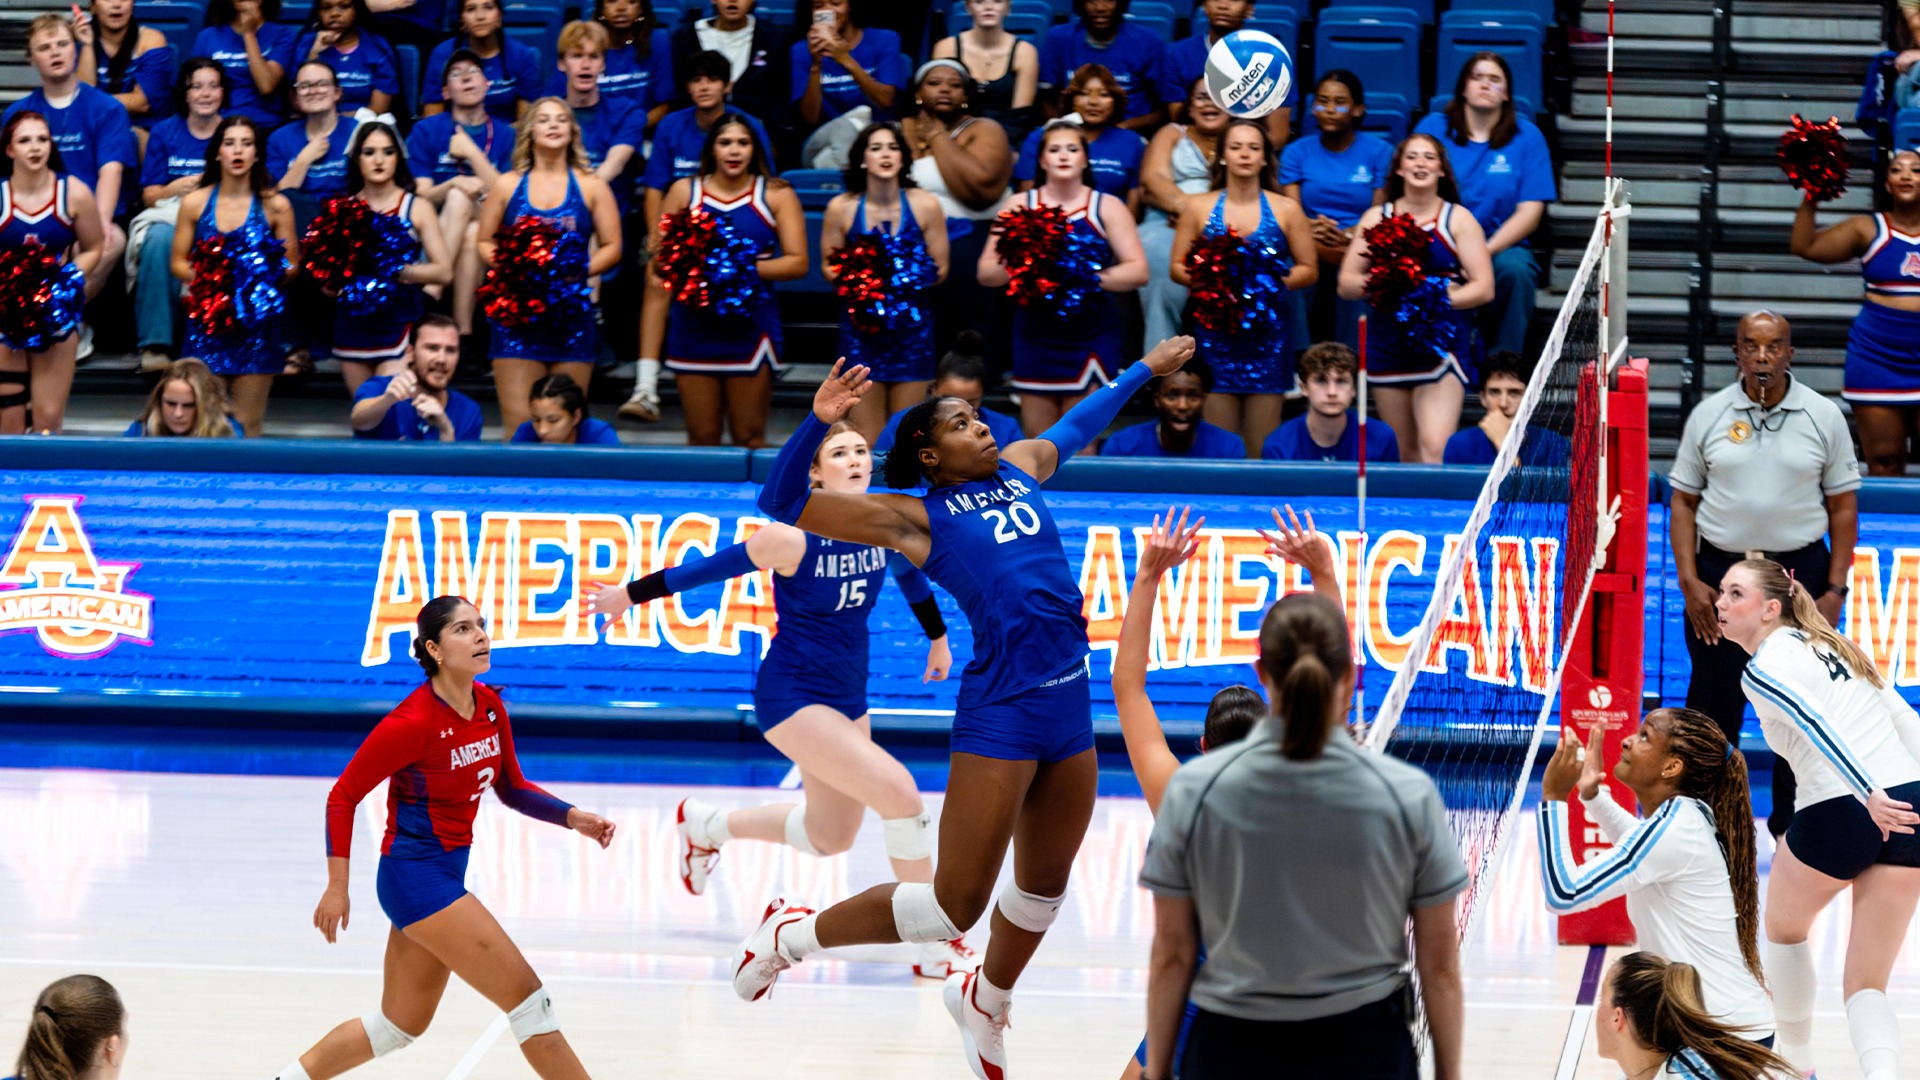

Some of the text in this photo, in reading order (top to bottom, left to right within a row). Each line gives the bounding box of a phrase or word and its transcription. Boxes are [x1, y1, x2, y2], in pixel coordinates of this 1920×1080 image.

[1228, 62, 1265, 101] molten
[1242, 76, 1274, 110] NCAA
[981, 501, 1041, 544] 20
[814, 546, 886, 578] AMERICAN
[361, 510, 778, 668] AMERICA
[835, 579, 868, 612] 15
[450, 732, 501, 771] AMERICA
[469, 766, 495, 802] 3
